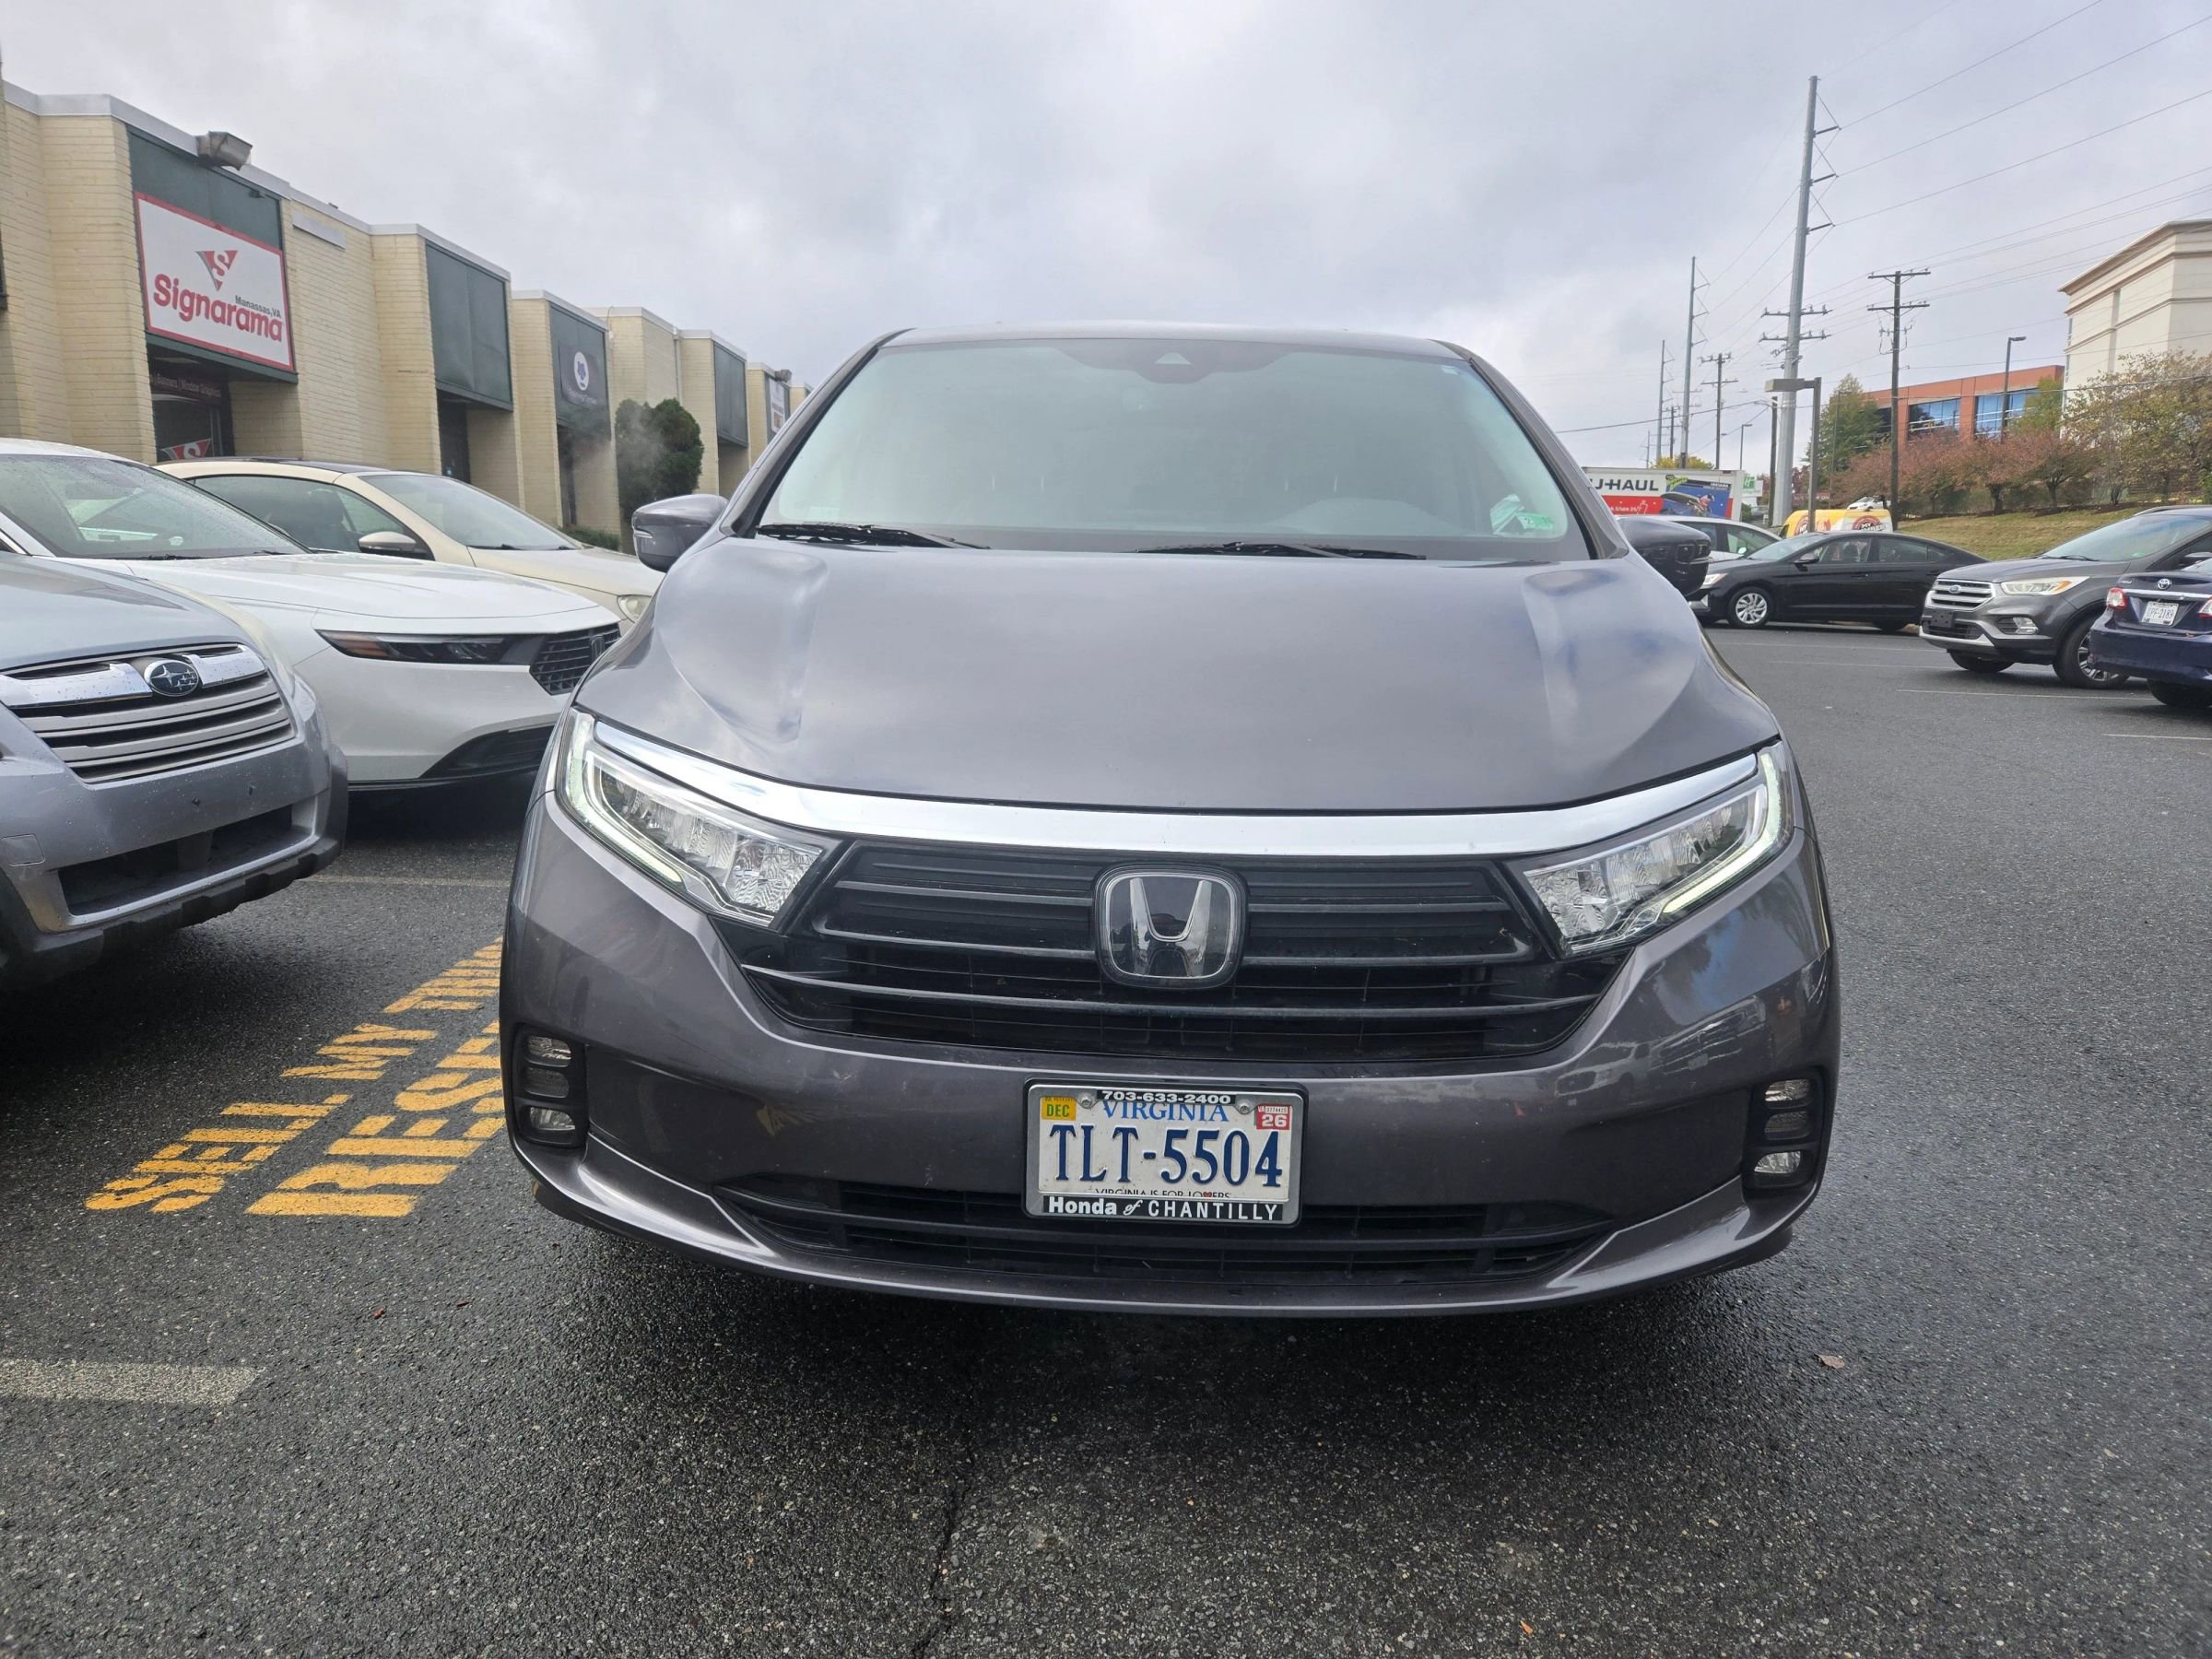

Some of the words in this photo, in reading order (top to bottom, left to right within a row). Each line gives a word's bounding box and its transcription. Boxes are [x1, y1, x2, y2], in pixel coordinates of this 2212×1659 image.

[153, 274, 283, 342] Signarama
[1101, 1090, 1231, 1104] 703-633-2400
[85, 1094, 354, 1213] SELL
[279, 1023, 438, 1080] MY
[1046, 1103, 1070, 1118] DEC
[1101, 1100, 1230, 1123] VIRGINIA
[1262, 1114, 1288, 1128] 26
[1049, 1124, 1283, 1187] TLT-5504
[1048, 1195, 1117, 1216] Honda
[1123, 1199, 1144, 1216] of
[1147, 1200, 1277, 1220] CHANTILLY
